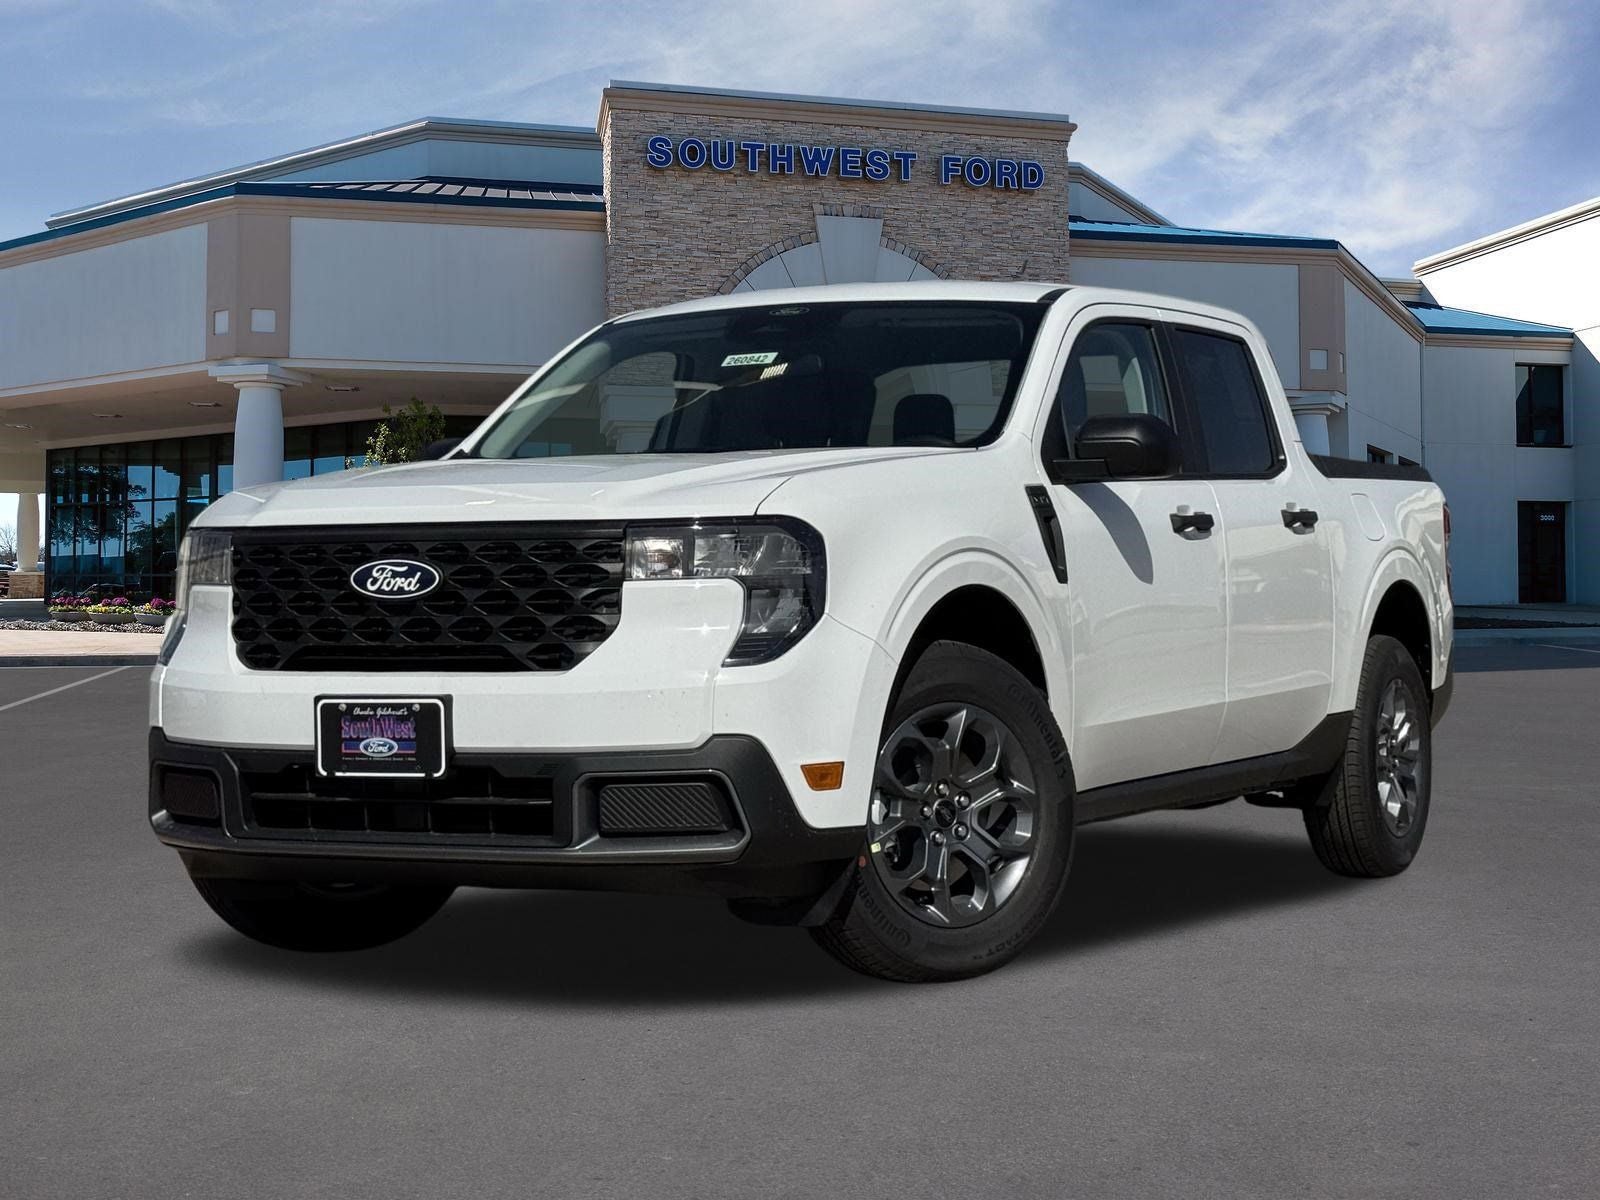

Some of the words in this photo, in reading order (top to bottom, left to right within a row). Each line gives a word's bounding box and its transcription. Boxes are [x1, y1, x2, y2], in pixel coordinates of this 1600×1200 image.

[646, 135, 918, 182] SOUTHWEST
[938, 154, 1045, 190] FORD
[726, 354, 769, 365] 260842
[366, 564, 422, 591] Ford
[367, 741, 389, 753] Ford
